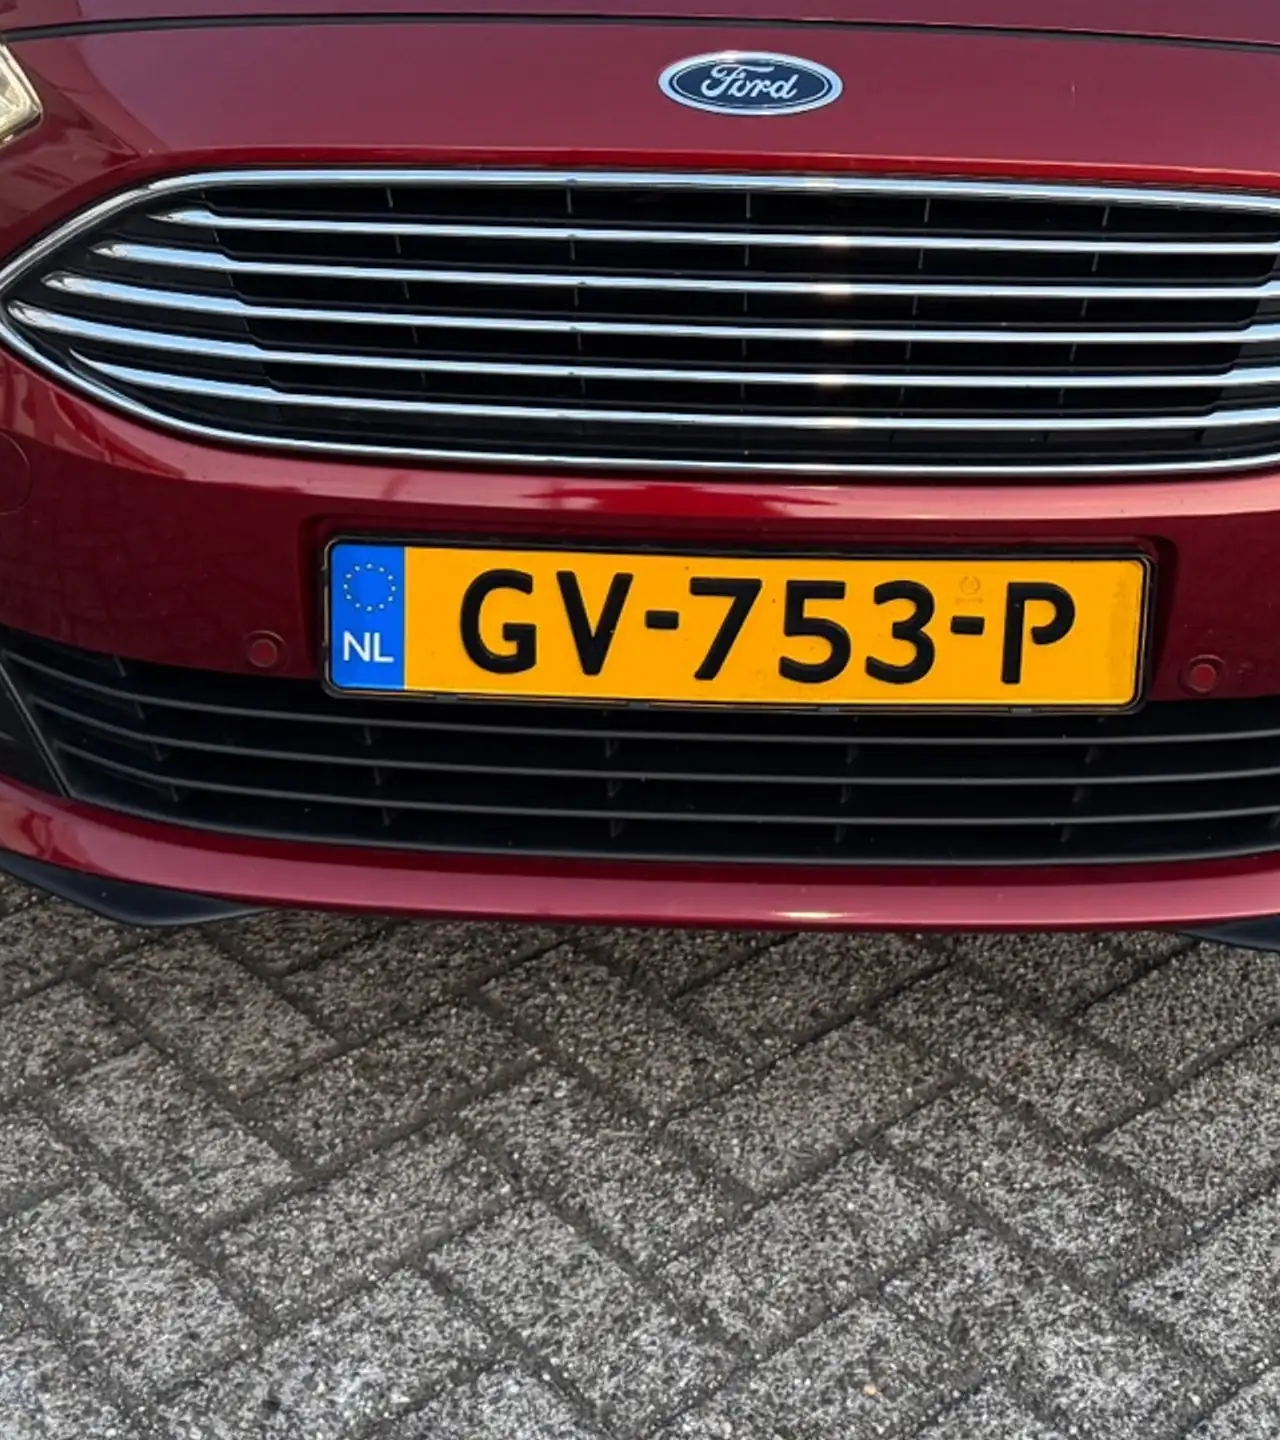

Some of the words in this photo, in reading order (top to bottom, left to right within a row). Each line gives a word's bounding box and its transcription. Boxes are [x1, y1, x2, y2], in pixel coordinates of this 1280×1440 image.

[700, 64, 800, 99] Ford
[459, 569, 1077, 686] GV-753-P
[342, 630, 394, 664] NL
